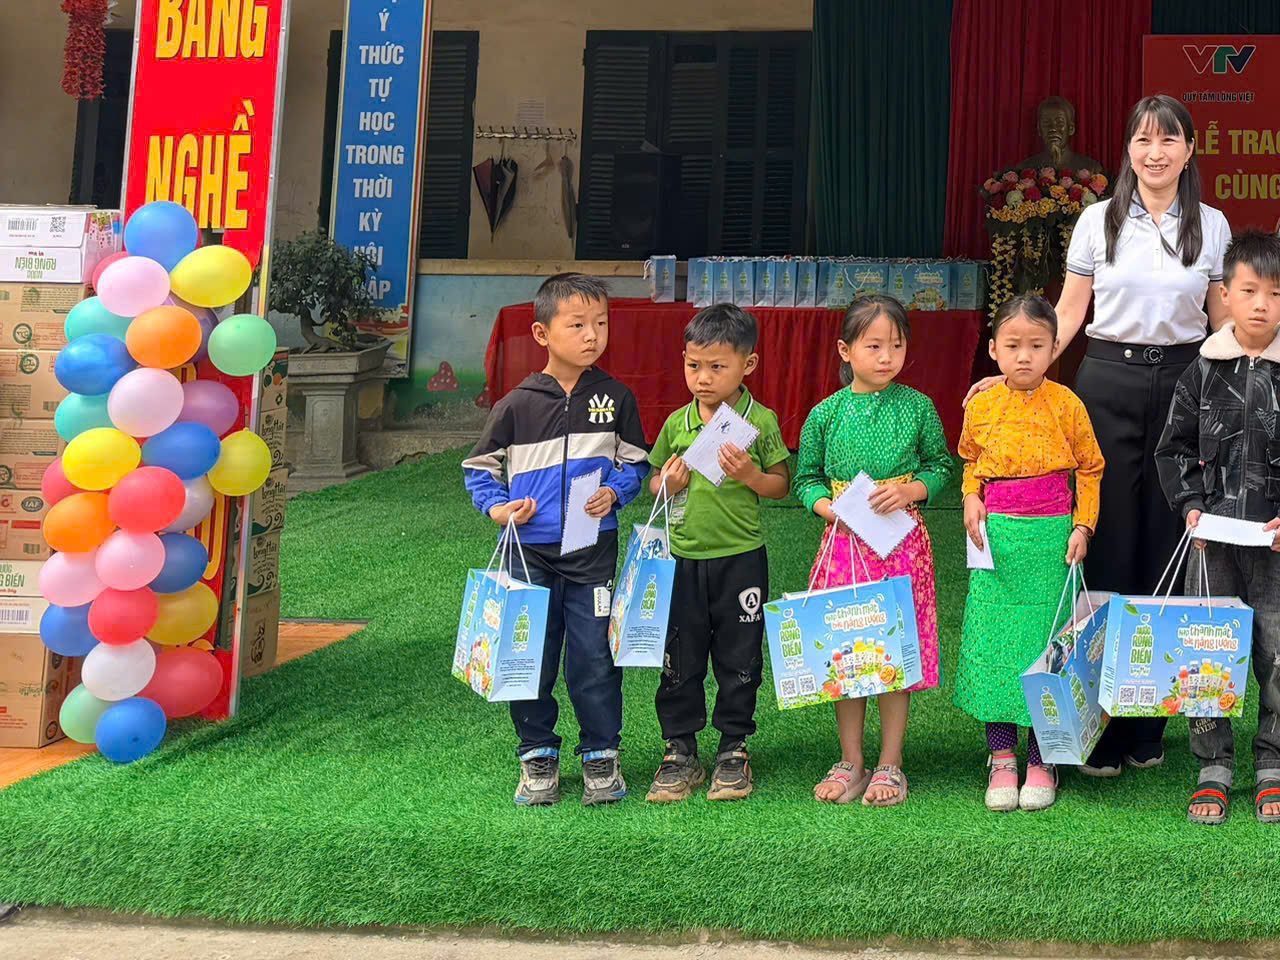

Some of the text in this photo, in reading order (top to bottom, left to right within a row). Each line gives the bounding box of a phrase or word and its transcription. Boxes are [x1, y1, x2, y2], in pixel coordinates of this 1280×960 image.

[379, 8, 390, 32] Ý
[359, 41, 404, 64] THỨC
[1183, 45, 1256, 74] VTV
[369, 77, 392, 102] TỰ
[359, 112, 395, 135] HỌC
[1195, 120, 1220, 155] LỄ
[144, 99, 255, 230] NGHỀ
[346, 145, 405, 165] TRONG
[353, 174, 392, 198] THỜI
[359, 208, 383, 232] KỲ
[365, 276, 391, 304] ẬP
